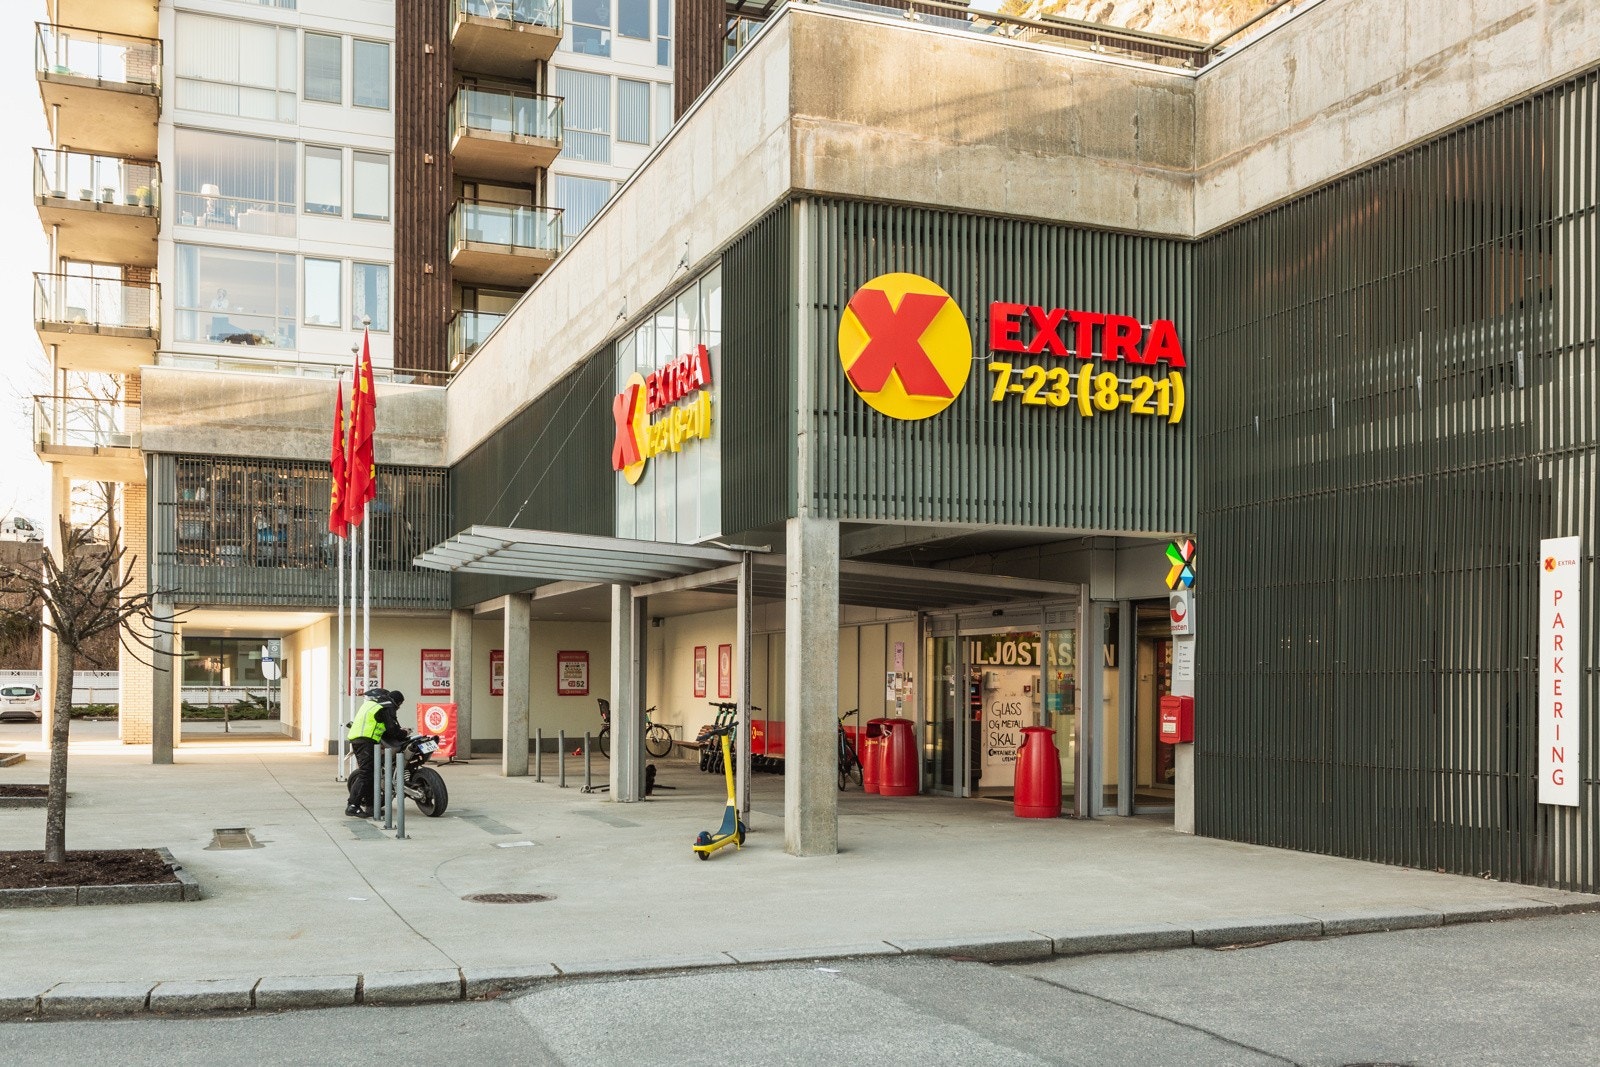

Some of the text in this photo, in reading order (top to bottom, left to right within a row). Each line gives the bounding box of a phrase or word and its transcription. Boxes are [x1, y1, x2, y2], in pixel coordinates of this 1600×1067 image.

[990, 302, 1187, 368] EXTRA
[646, 344, 711, 414] EXTRA
[950, 640, 1114, 667] ILJØSTASN
[1552, 590, 1565, 786] PARKERING
[991, 701, 1022, 718] GLASS
[988, 720, 1000, 730] OG
[989, 732, 1016, 747] SKAL
